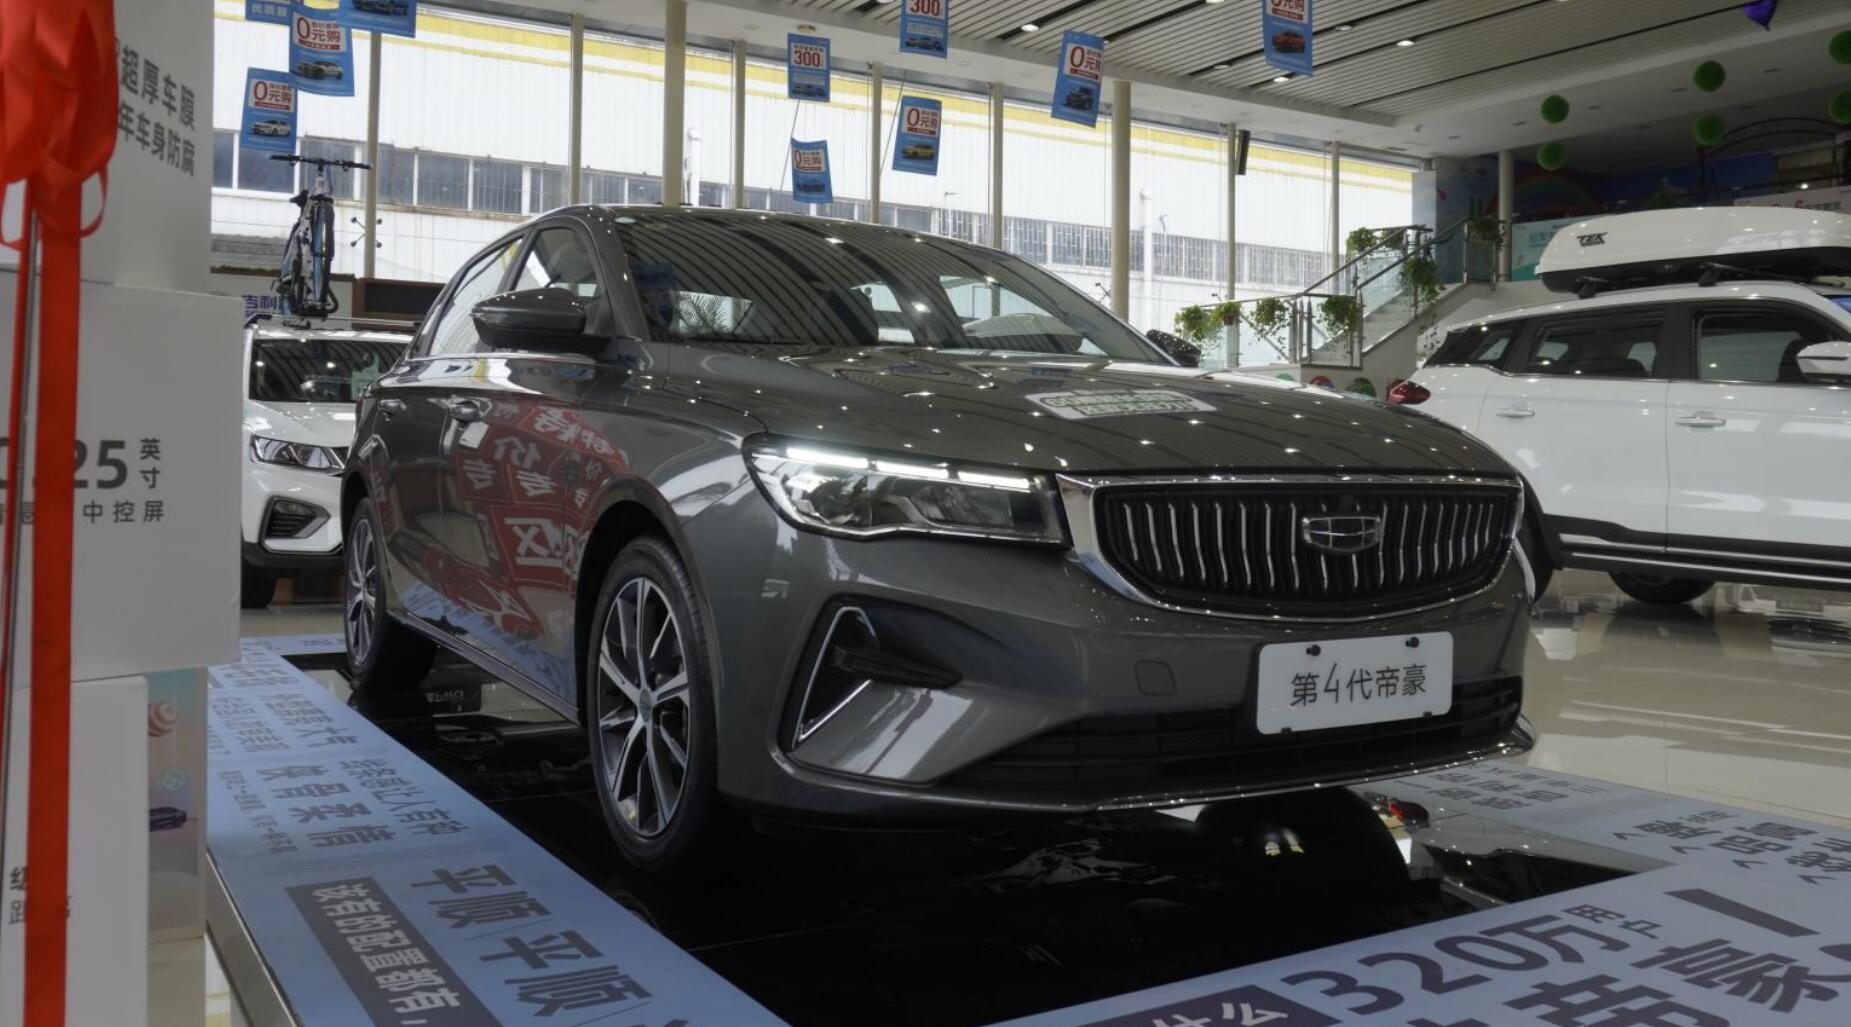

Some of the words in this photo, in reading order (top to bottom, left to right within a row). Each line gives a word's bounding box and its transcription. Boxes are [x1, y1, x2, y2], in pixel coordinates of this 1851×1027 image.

[296, 16, 341, 42] 0元购
[121, 44, 195, 131] 超厚车膜
[794, 50, 820, 67] 300
[117, 105, 195, 177] 年车身防腐
[138, 438, 161, 489] 英寸
[83, 500, 164, 524] 中控屏
[1291, 662, 1427, 708] 第4代帝豪
[411, 864, 551, 929] 平顺
[480, 930, 653, 1018] 平顺
[1280, 914, 1631, 1017] 320万
[1561, 903, 1663, 940] 用户
